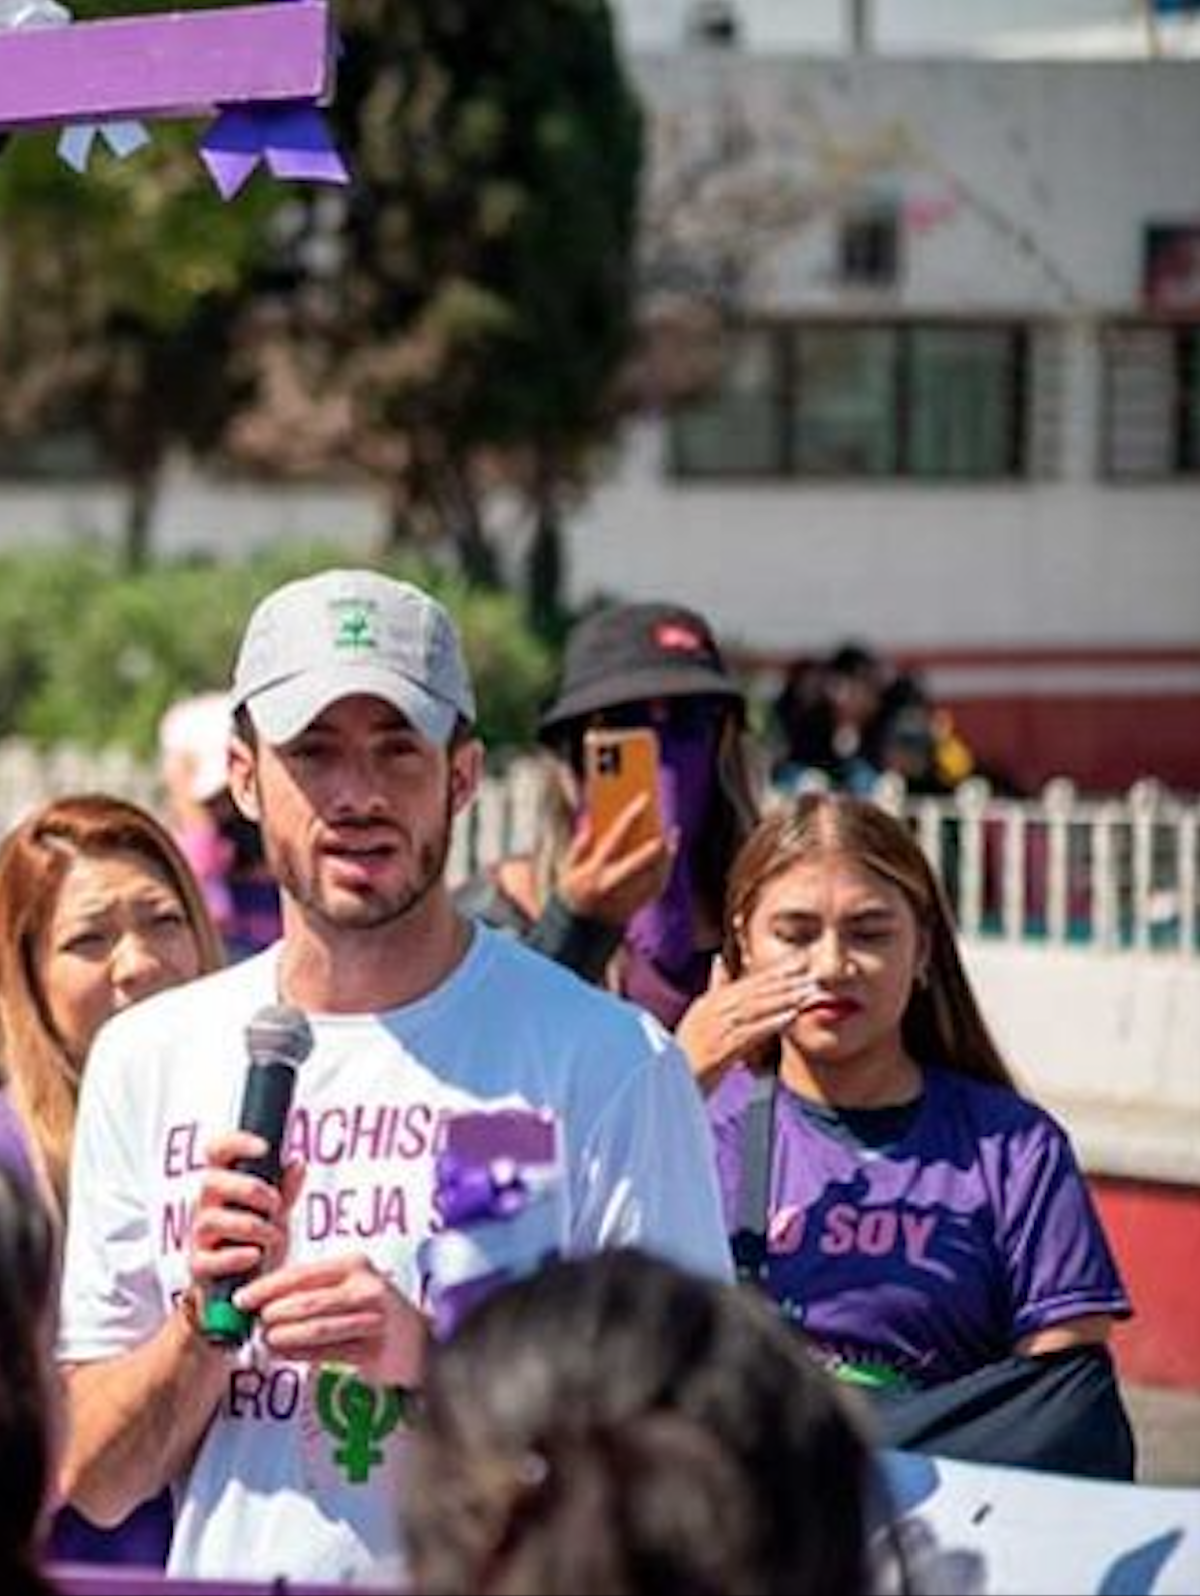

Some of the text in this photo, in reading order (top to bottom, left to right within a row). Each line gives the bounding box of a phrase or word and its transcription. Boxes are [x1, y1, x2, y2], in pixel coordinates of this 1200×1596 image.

[164, 1104, 446, 1178] EL ACHIS
[308, 1186, 407, 1242] DEJA
[819, 1203, 936, 1260] SOY
